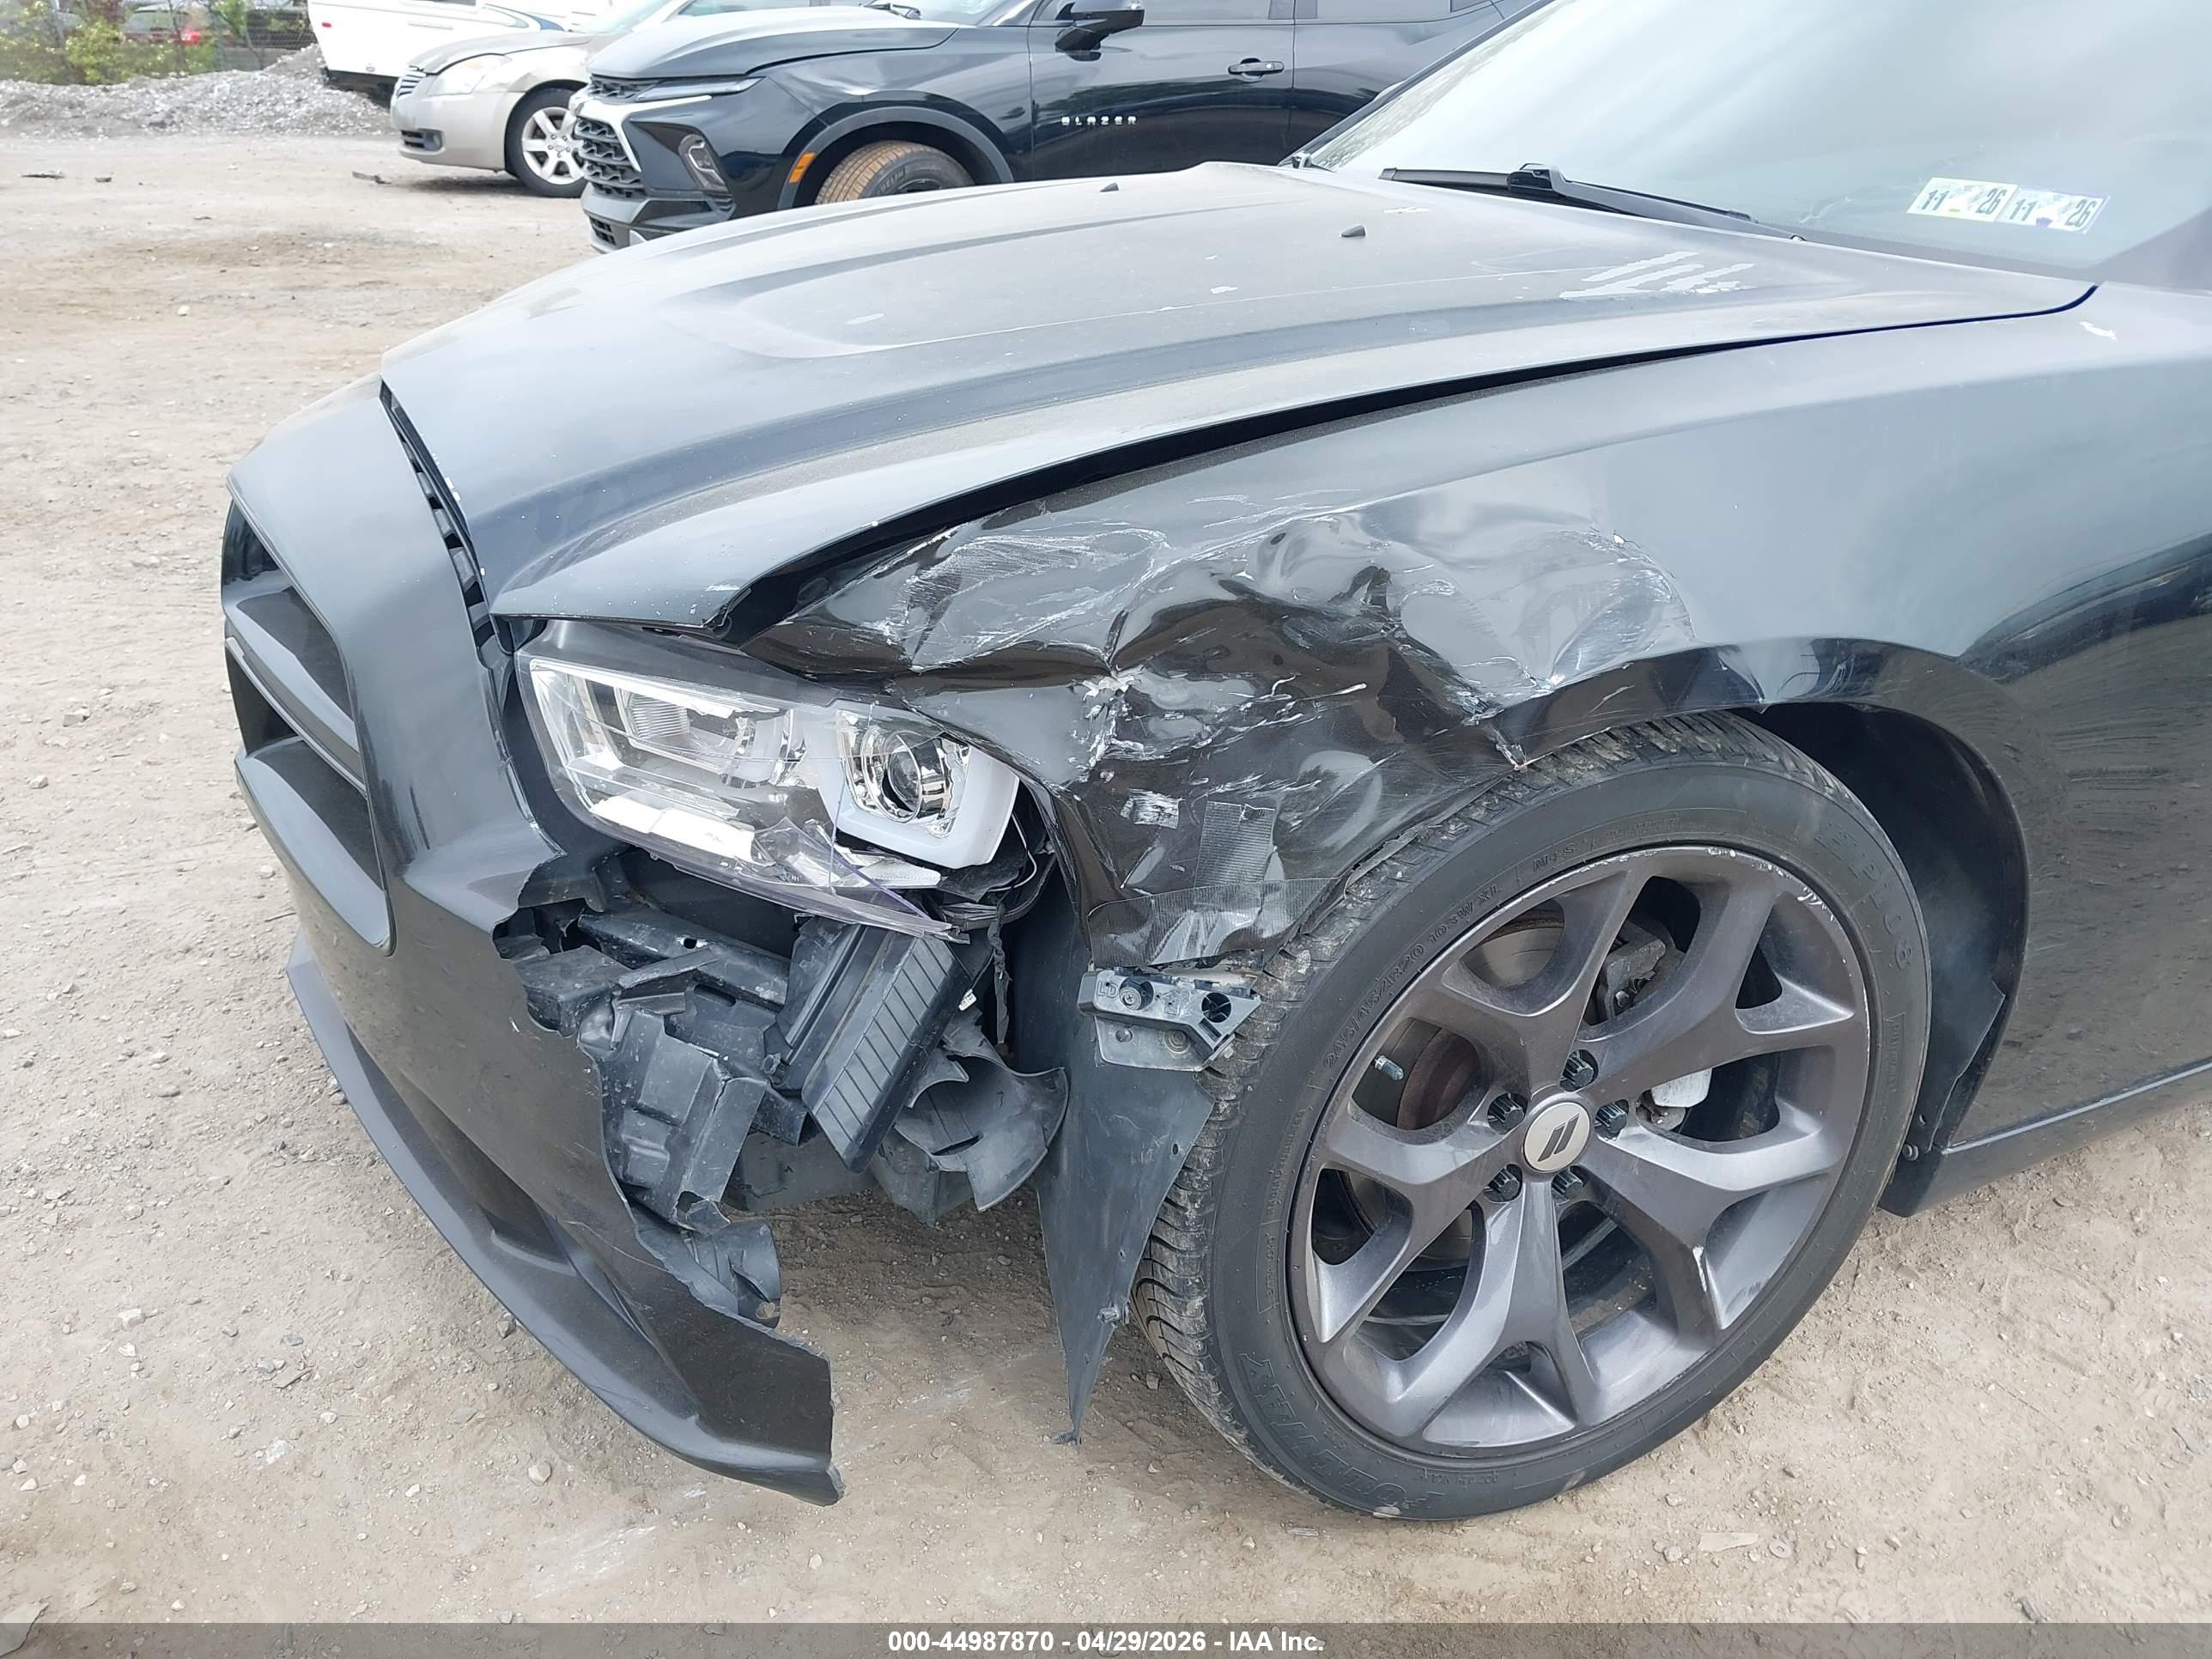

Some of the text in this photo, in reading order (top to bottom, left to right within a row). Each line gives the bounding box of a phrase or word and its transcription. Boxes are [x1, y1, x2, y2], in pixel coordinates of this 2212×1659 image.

[1061, 116, 1137, 126] BLAZER
[1975, 188, 2008, 215] 26
[2063, 198, 2098, 228] 26
